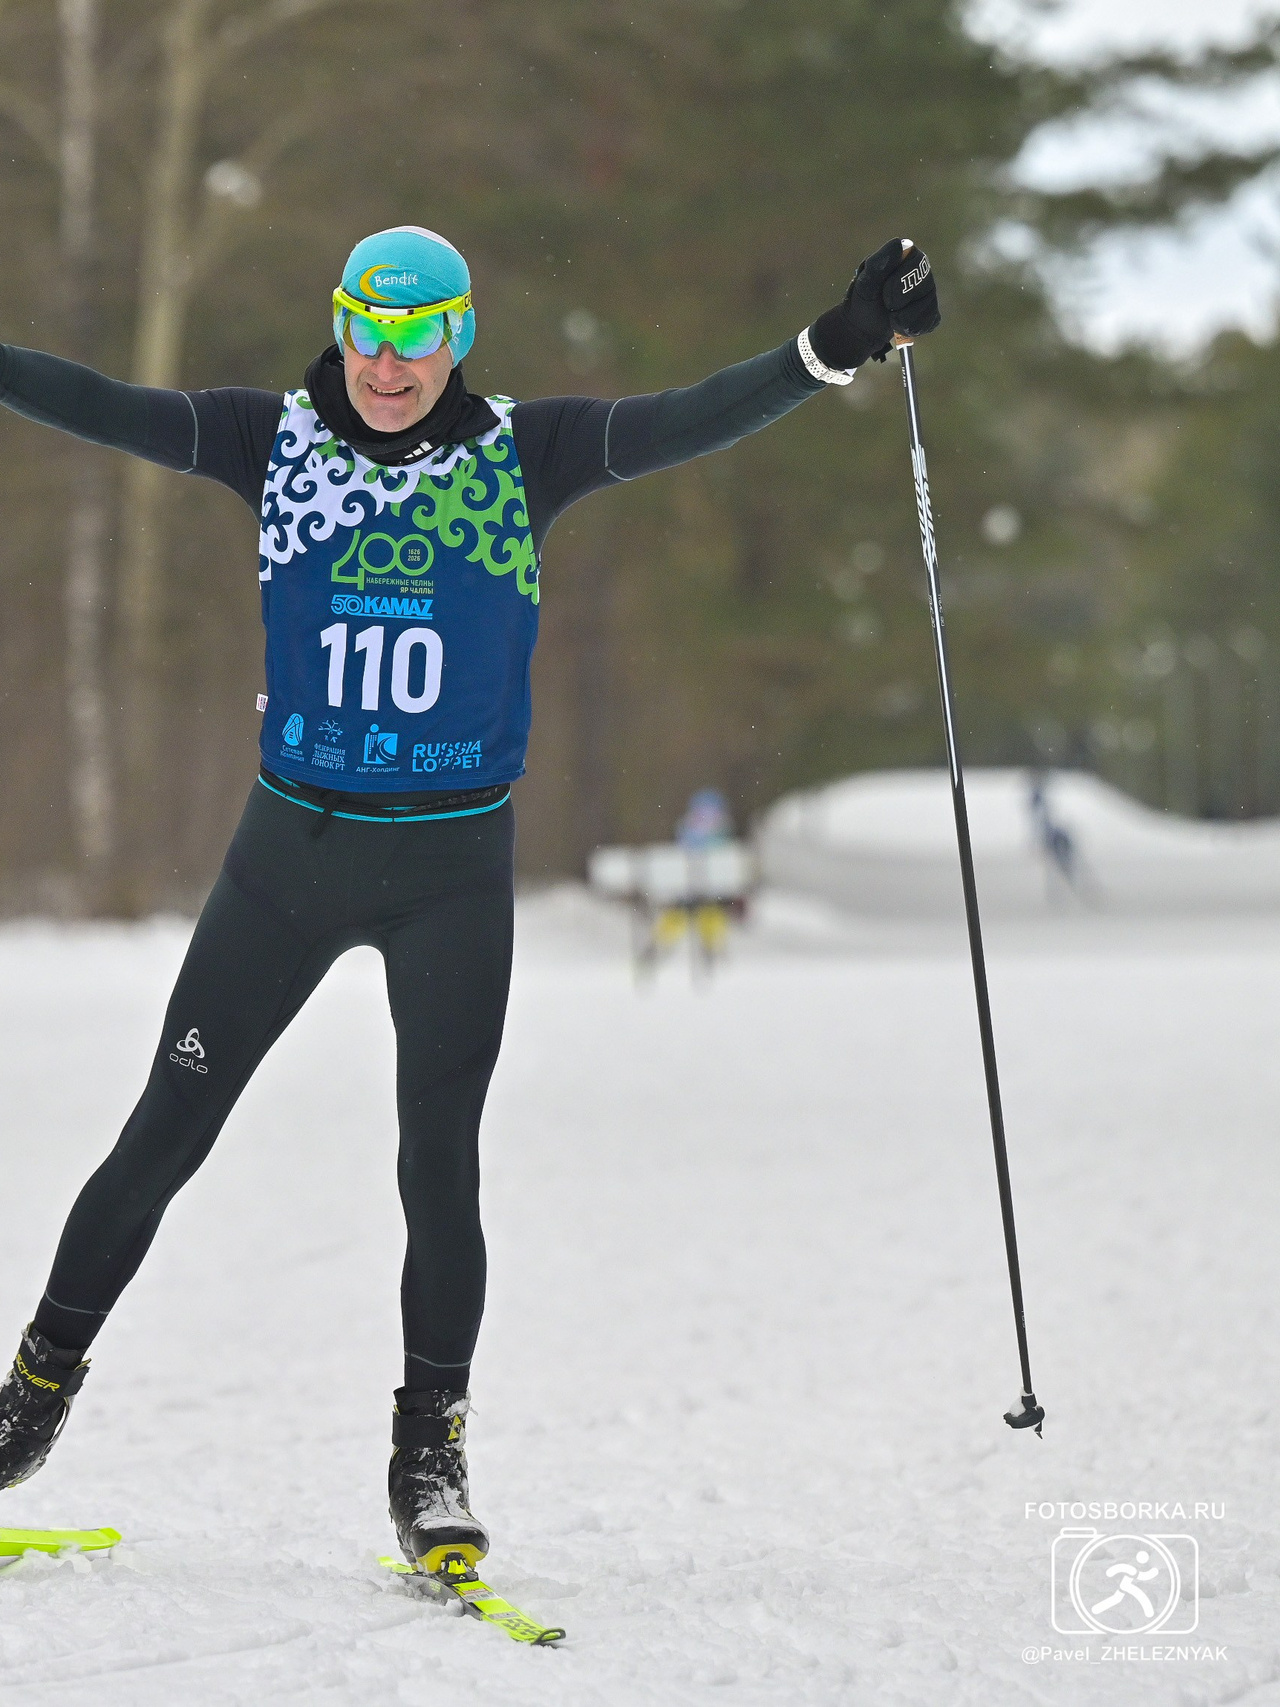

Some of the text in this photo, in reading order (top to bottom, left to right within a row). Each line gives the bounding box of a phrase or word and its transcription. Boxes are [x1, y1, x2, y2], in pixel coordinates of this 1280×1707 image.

[374, 272, 419, 288] Bendit
[331, 529, 434, 591] 400
[366, 577, 409, 586] НАБЕРЕЖНЫЕ
[364, 596, 434, 617] KAMAZ
[320, 622, 444, 714] 110
[312, 750, 345, 764] ЛЫЖНЫХ
[413, 740, 483, 758] RUSSIA
[311, 758, 334, 769] ГОНОК
[356, 766, 400, 774] АНГ-Холдинг
[412, 754, 483, 772] LOPPET
[169, 1053, 208, 1074] odlo
